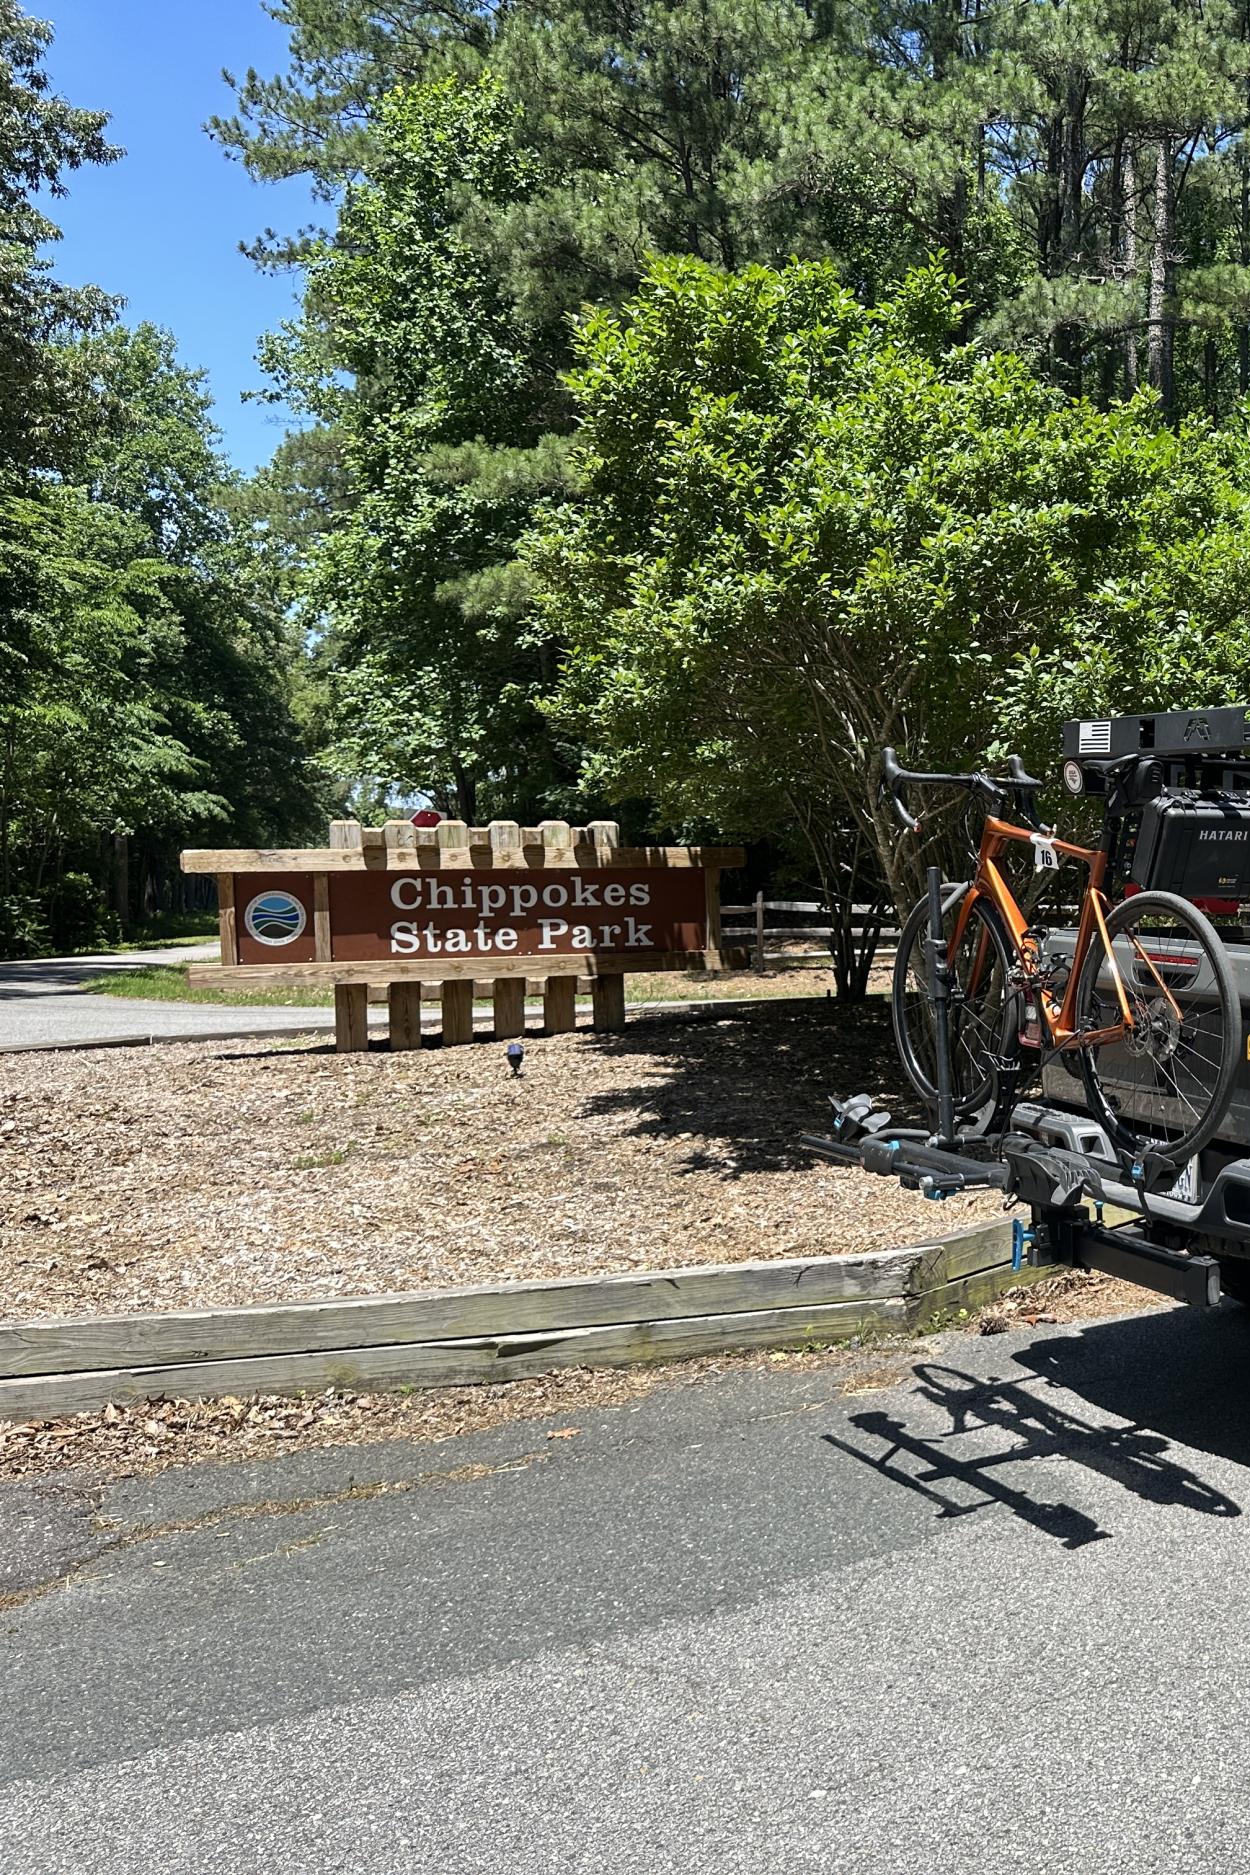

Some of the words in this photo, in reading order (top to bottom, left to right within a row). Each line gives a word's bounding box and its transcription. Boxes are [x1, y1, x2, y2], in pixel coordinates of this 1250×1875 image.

[1199, 830, 1249, 841] HATARI
[1040, 849, 1053, 866] 16
[390, 876, 651, 917] Chippokes
[390, 920, 518, 954] State
[537, 916, 654, 949] Park
